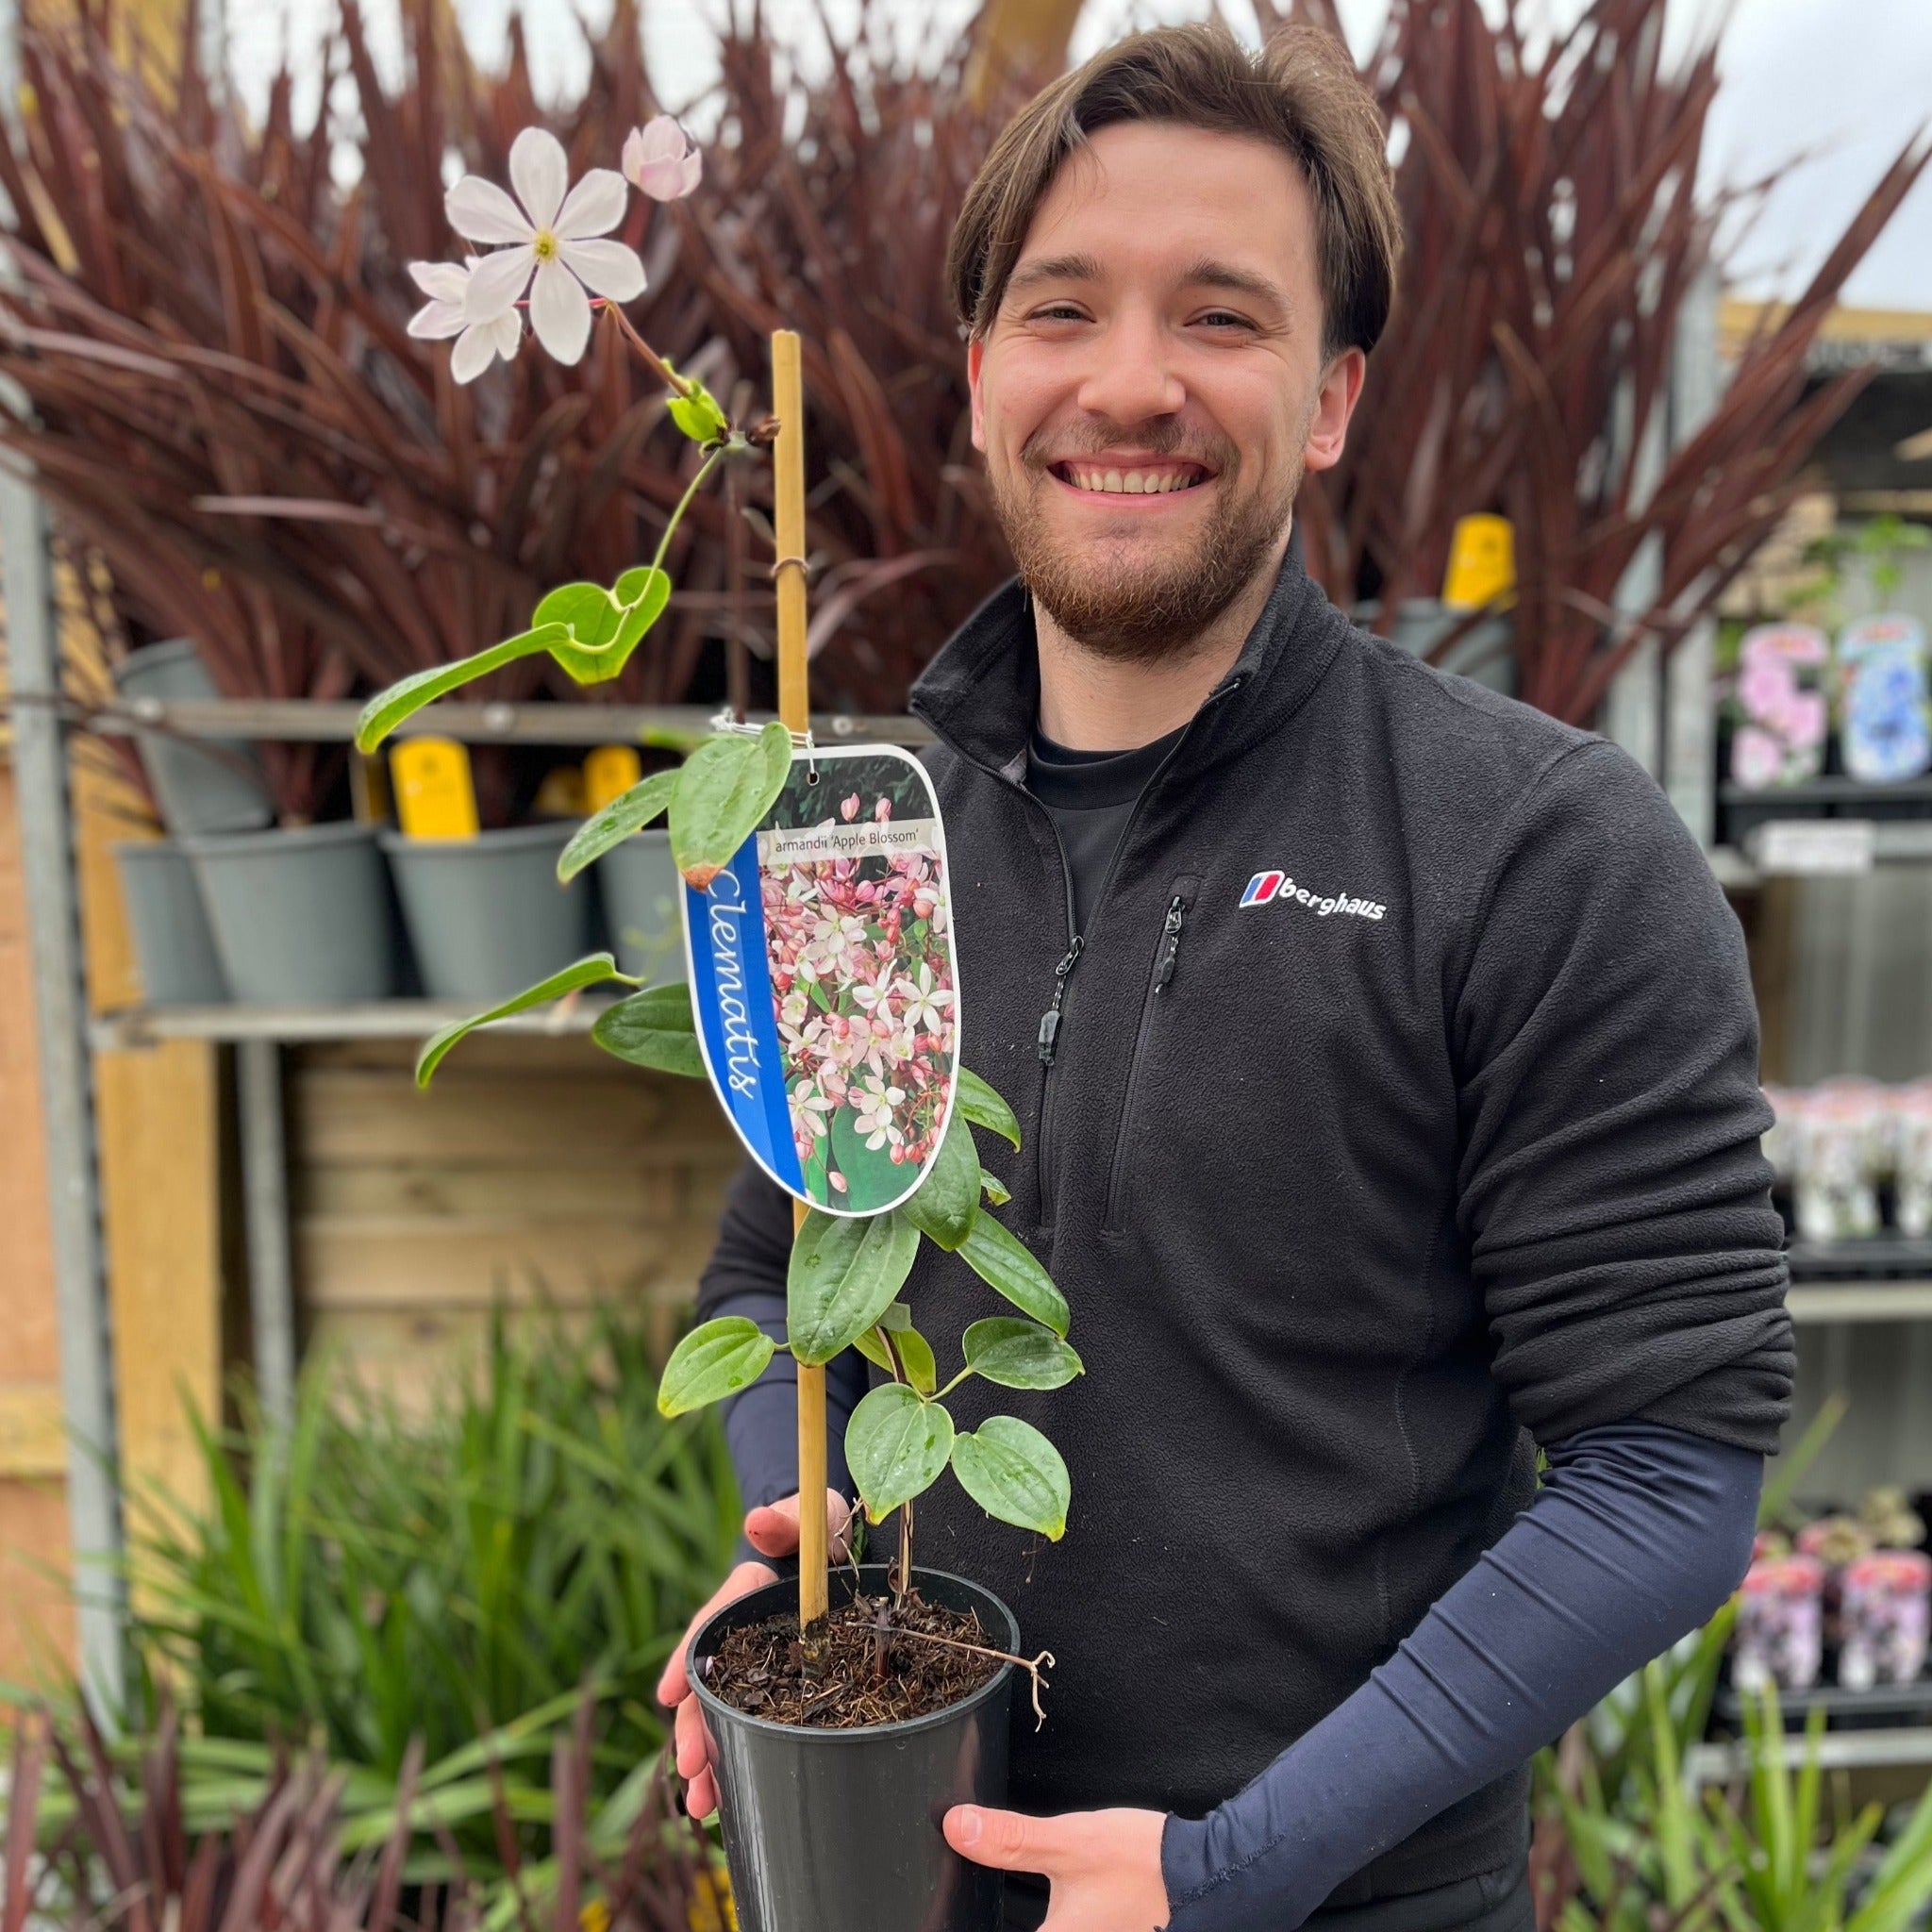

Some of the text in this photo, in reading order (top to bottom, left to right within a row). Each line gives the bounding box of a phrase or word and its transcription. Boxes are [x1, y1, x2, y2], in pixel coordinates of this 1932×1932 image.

[775, 835, 828, 853] armandii
[1278, 877, 1387, 920] berghaus
[708, 869, 762, 1101] Clematis
